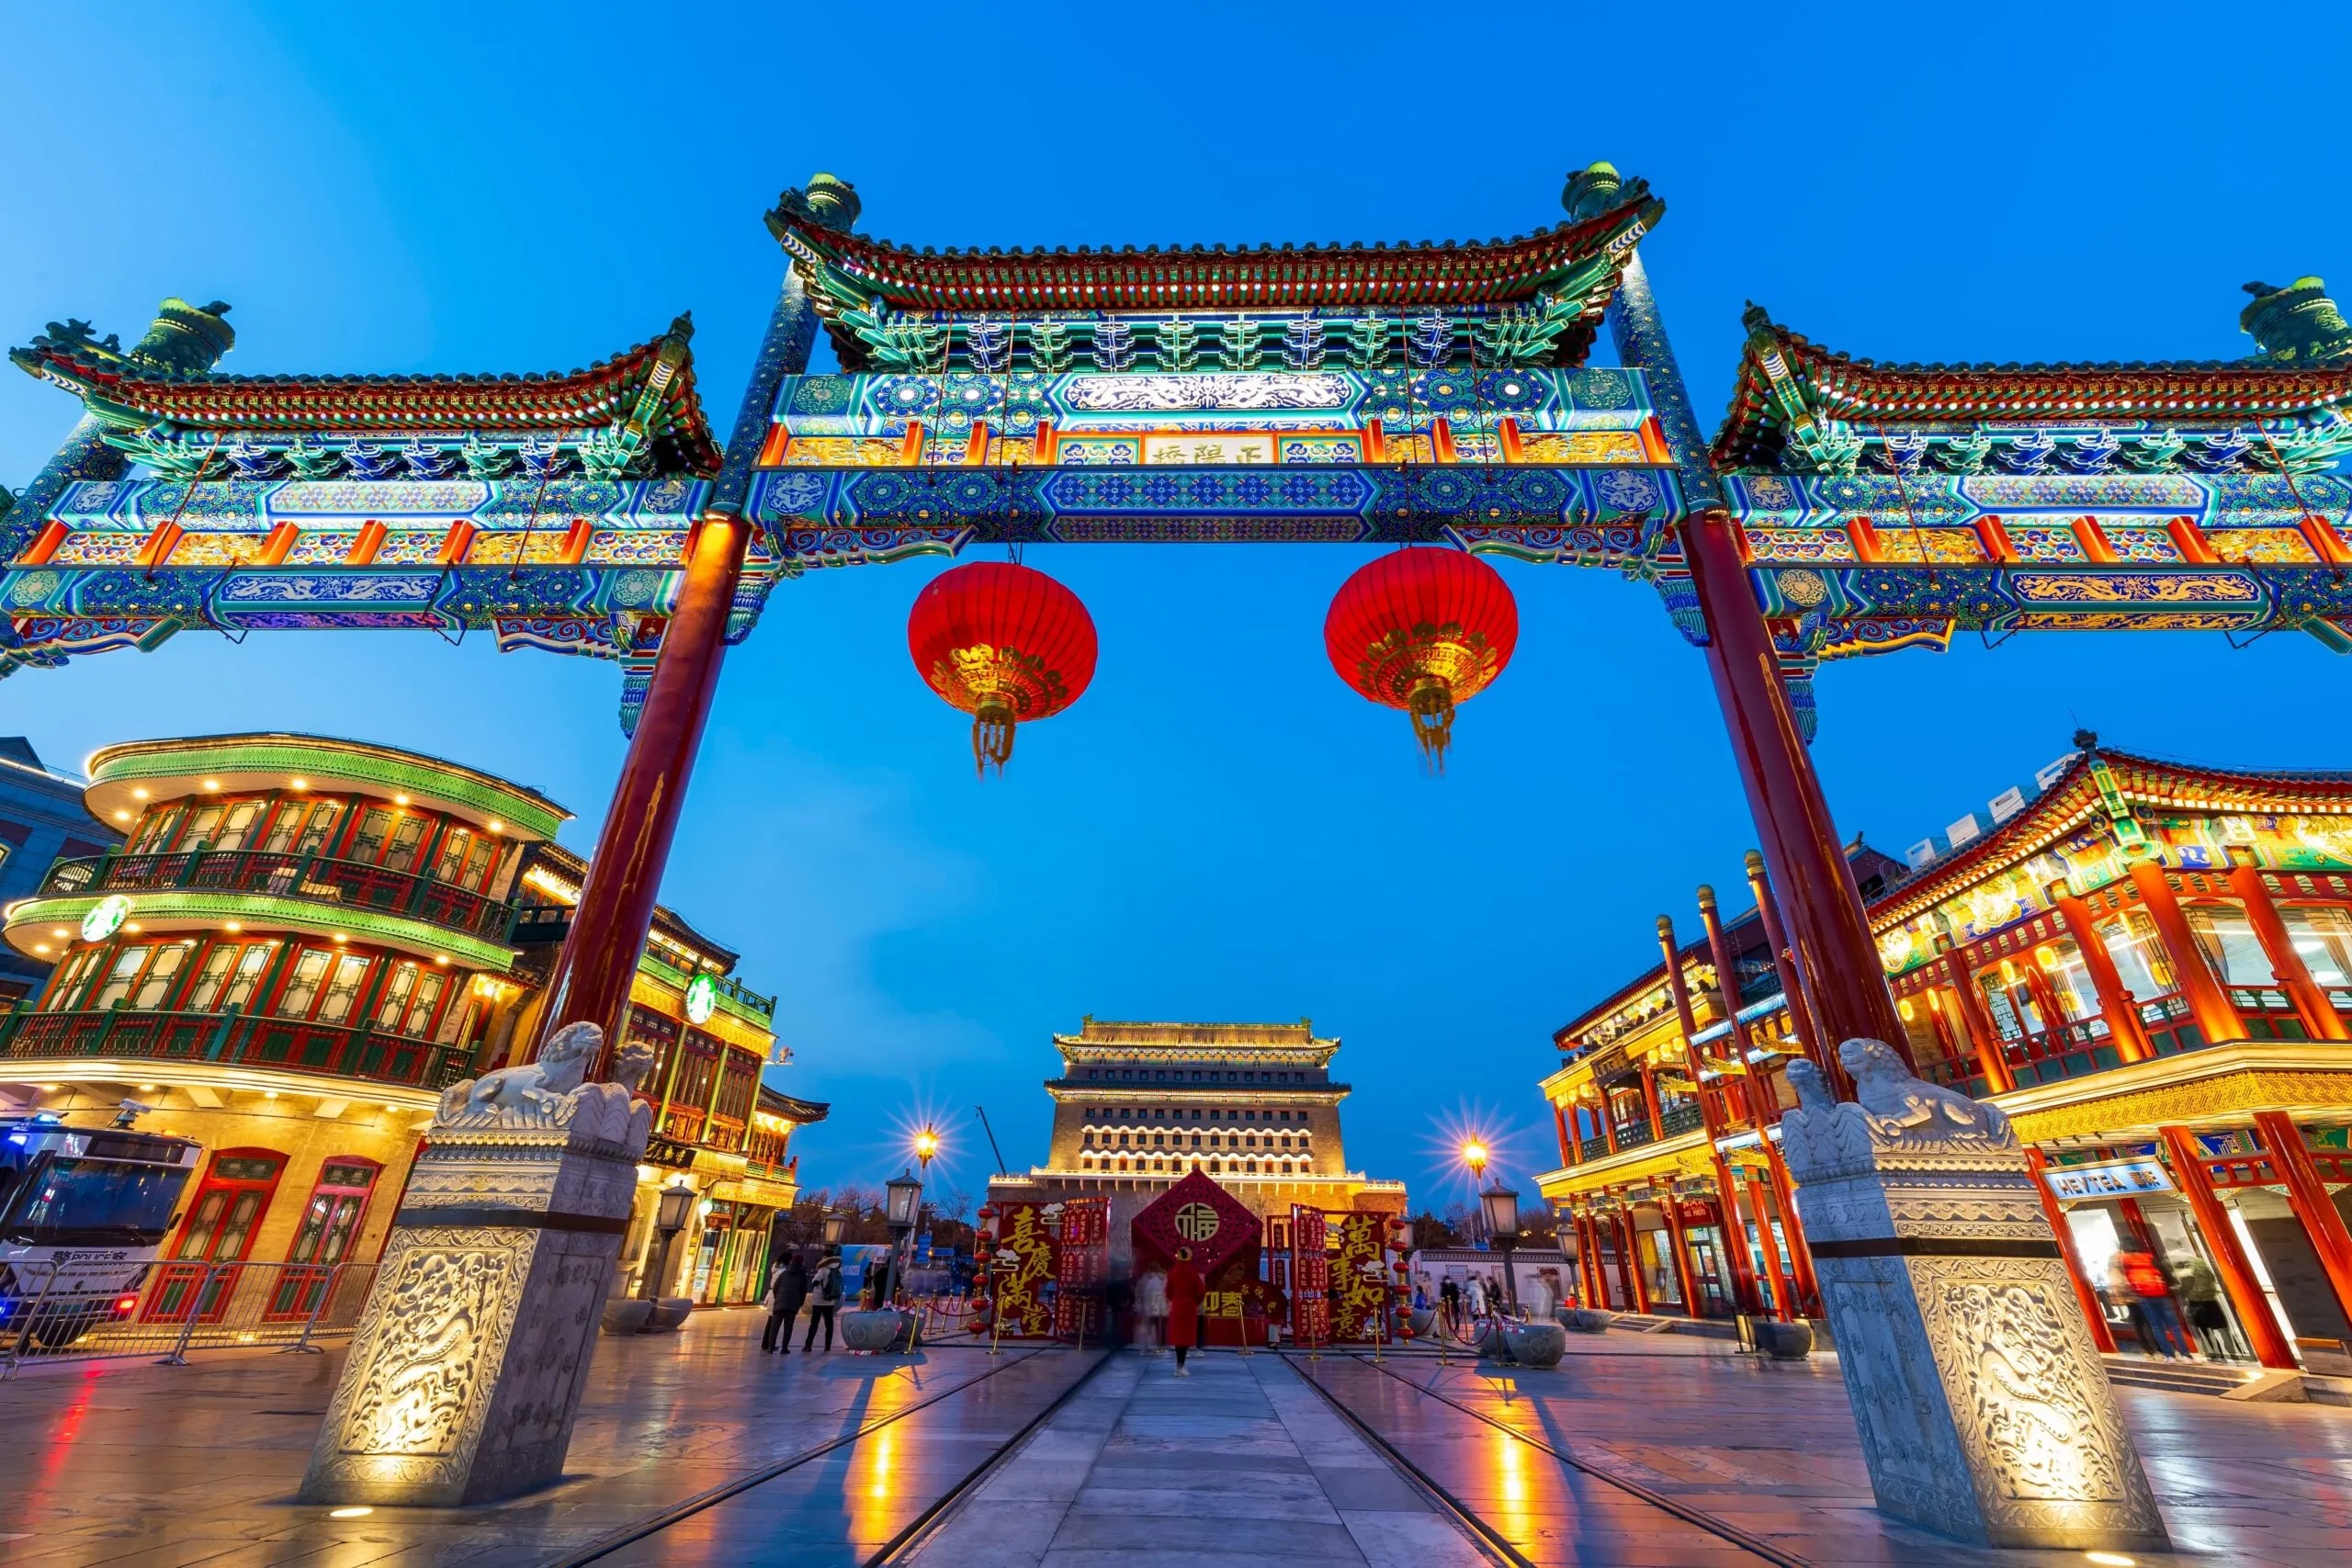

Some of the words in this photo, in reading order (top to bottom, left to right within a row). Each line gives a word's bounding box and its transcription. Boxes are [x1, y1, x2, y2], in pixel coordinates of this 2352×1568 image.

[2056, 1174, 2128, 1195] HEYTEA
[1174, 1201, 1220, 1242] 福
[1327, 1214, 1385, 1339] 萬事如意
